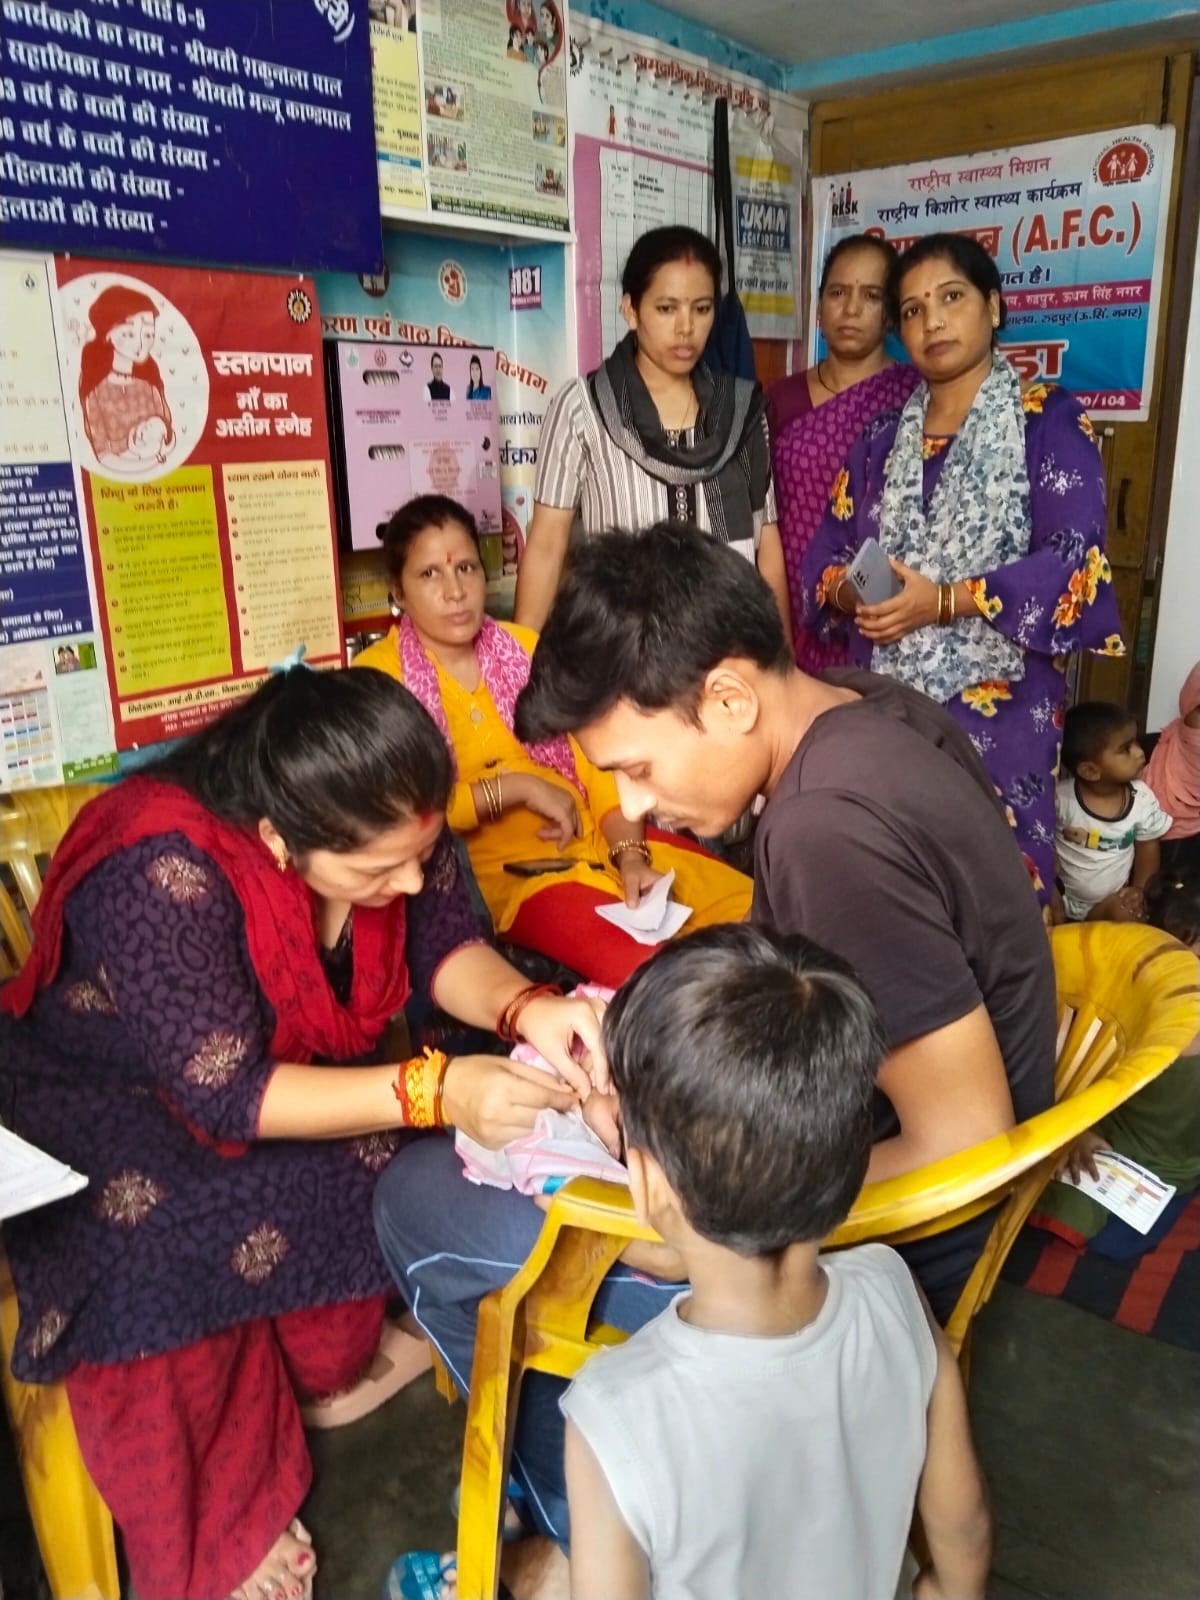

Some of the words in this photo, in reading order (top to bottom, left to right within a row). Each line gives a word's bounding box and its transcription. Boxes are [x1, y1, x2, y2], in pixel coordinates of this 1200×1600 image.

[6, 37, 100, 80] सहायिका
[103, 59, 131, 86] का
[135, 66, 172, 95] नाम
[192, 75, 246, 110] श्रीमती
[95, 19, 123, 48] का
[126, 26, 165, 57] नाम
[185, 38, 239, 75] श्रीमती
[312, 72, 343, 99] पाल
[21, 80, 53, 110] वर्ष
[57, 84, 78, 113] के
[82, 92, 127, 123] बच्चों
[130, 99, 157, 128] की
[161, 104, 210, 136] संख्या
[20, 119, 53, 148] वर्ष
[56, 122, 77, 150] के
[81, 130, 125, 160] बच्चों
[129, 135, 156, 163] की
[159, 139, 209, 172] संख्या
[89, 165, 117, 194] की
[120, 169, 171, 200] संख्या
[907, 169, 952, 194] राष्ट्रीय
[957, 164, 1004, 185] स्वास्थ्य
[1008, 156, 1052, 177] मिशन
[71, 199, 99, 229] की
[103, 202, 155, 235] संख्या
[876, 201, 920, 224] राष्ट्रीय
[925, 194, 970, 218] किशोर
[974, 191, 1022, 211] स्वास्थ्य
[1026, 178, 1083, 204] कार्यक्रम
[1011, 201, 1142, 267] (A.F.C.)
[514, 266, 541, 296] 181
[1092, 284, 1113, 300] सिंह
[1116, 285, 1143, 298] नगर
[211, 350, 313, 377] स्तनपान
[364, 312, 392, 342] एवं
[398, 319, 431, 343] बाल
[495, 350, 549, 396] विभाग
[235, 385, 260, 412] माँ
[263, 391, 288, 412] का
[215, 412, 271, 438] असीम
[275, 413, 312, 438] स्नेह
